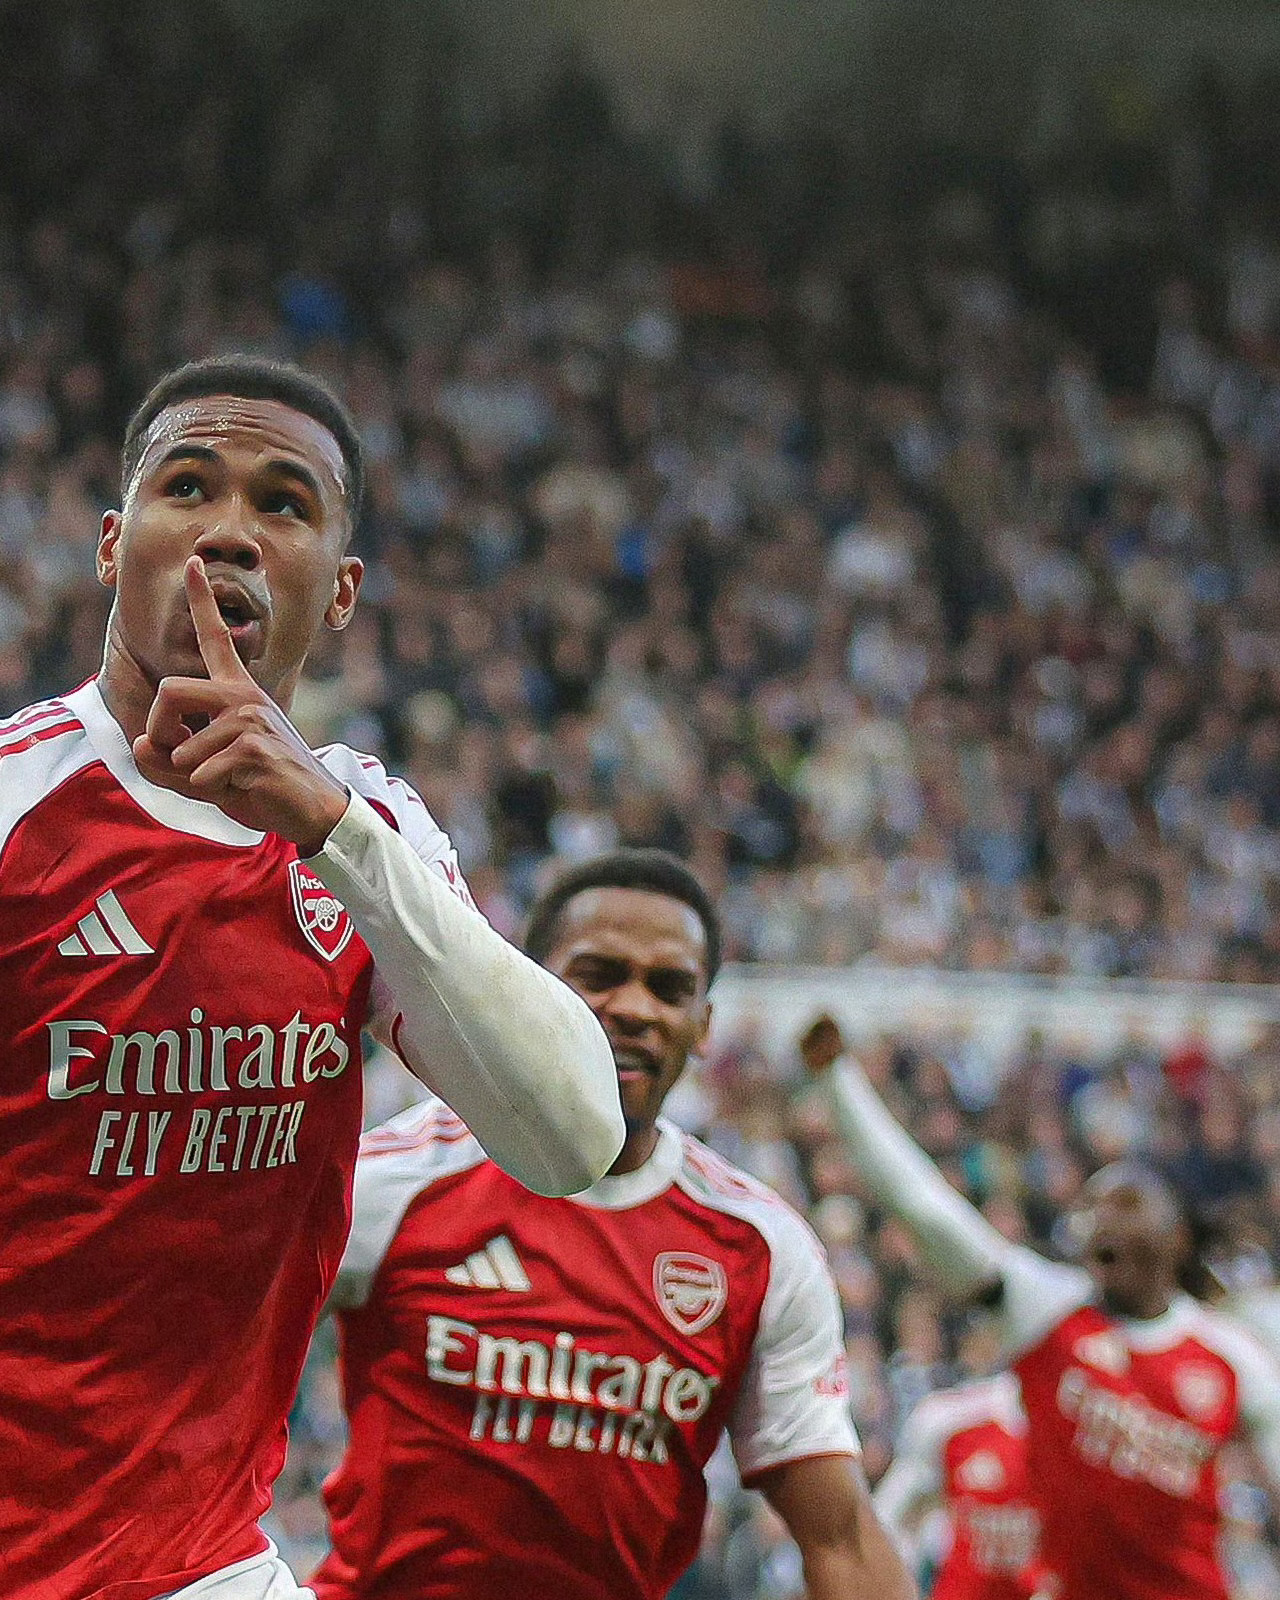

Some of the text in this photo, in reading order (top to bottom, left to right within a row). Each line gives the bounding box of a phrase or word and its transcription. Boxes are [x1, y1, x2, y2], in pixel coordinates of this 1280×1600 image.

[45, 1007, 350, 1100] Emirates
[88, 1100, 306, 1176] FLY BETTER
[425, 1314, 720, 1423] Emirate
